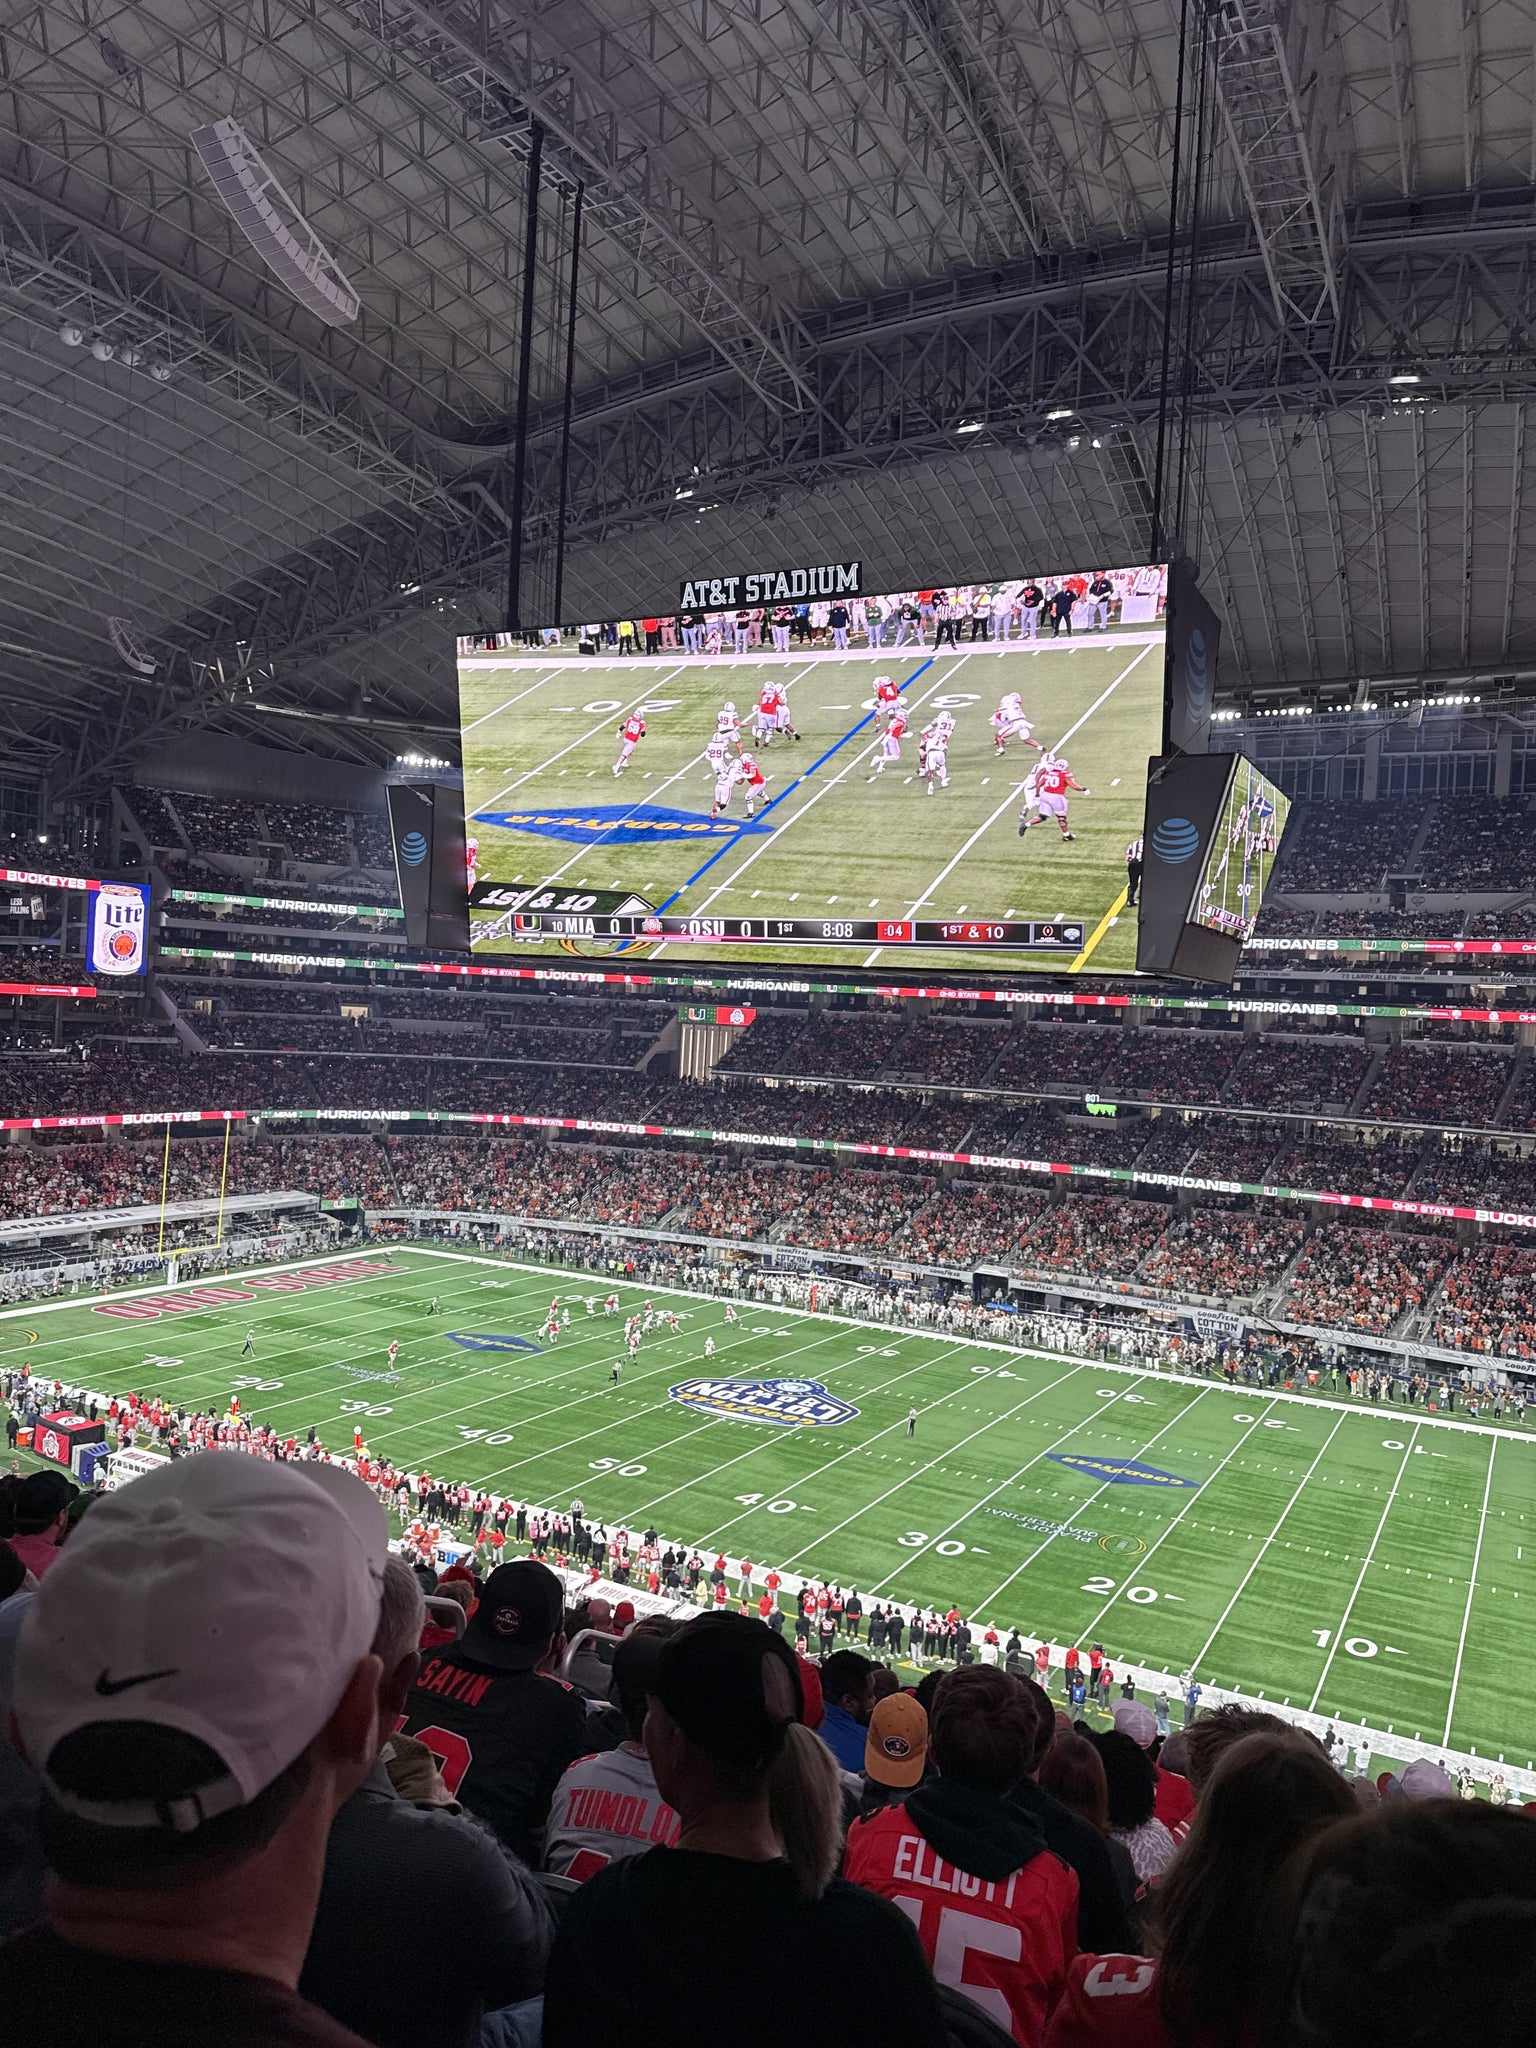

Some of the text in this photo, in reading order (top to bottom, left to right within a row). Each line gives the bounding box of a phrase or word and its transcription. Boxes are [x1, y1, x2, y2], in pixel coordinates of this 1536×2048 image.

[680, 563, 859, 609] AT&T STADIUM
[504, 814, 741, 832] GOODYEAR
[6, 869, 87, 890] BUCKEYES
[9, 905, 30, 915] FILLING
[10, 897, 23, 906] LESS
[223, 895, 246, 905] MIAMI
[263, 898, 358, 916] HURRICANES
[479, 888, 598, 912] 1st & 10
[104, 902, 143, 929] Lite
[551, 920, 564, 933] 10
[564, 918, 596, 934] MIA
[609, 918, 621, 934] 0
[680, 919, 752, 937] 2 OSU 0
[776, 921, 904, 938] 1ST 8:08 :04
[940, 924, 1005, 939] 1ST & 10
[212, 951, 235, 960] MIAMI
[251, 952, 346, 968] HURRICANES
[534, 969, 606, 983] BUCKEYES
[726, 979, 811, 993] HURRICANES
[994, 990, 1075, 1005] BUCKEYES
[1183, 1000, 1209, 1009] MIAMI
[1227, 1000, 1339, 1015] HURRICANES
[122, 1111, 202, 1125] BUCKEYES
[315, 1109, 411, 1121] HURRICANES
[576, 1120, 646, 1134] BUCKEYES
[711, 1130, 798, 1147] HURRICANES
[968, 1154, 1052, 1173] BUCKEYES
[1131, 1170, 1243, 1195] HURRICANES
[1391, 1202, 1418, 1212] OHIO
[1419, 1205, 1455, 1216] STATE
[91, 1259, 411, 1320] OHIO STATE
[1141, 1300, 1178, 1312] GOODYEAR
[1197, 1310, 1240, 1323] GOODYEAR
[1197, 1318, 1239, 1332] COTTON
[856, 1345, 901, 1358] 50
[230, 1376, 285, 1391] 20
[339, 1400, 394, 1417] 30
[686, 1382, 842, 1421] COTTON
[1232, 1414, 1288, 1430] 20
[459, 1427, 514, 1446] 40
[1381, 1439, 1430, 1455] 10
[588, 1457, 648, 1477] 50
[1061, 1456, 1185, 1486] GOODYEAR
[733, 1491, 797, 1514] 40
[982, 1506, 1100, 1539] QUARTERFINAL
[1016, 1522, 1094, 1544] PLAYOFF
[897, 1530, 967, 1557] 30
[596, 1586, 666, 1611] OHIO STATE
[1079, 1575, 1159, 1605] 20
[1310, 1628, 1379, 1659] 10
[416, 1659, 494, 1708] SAYIN
